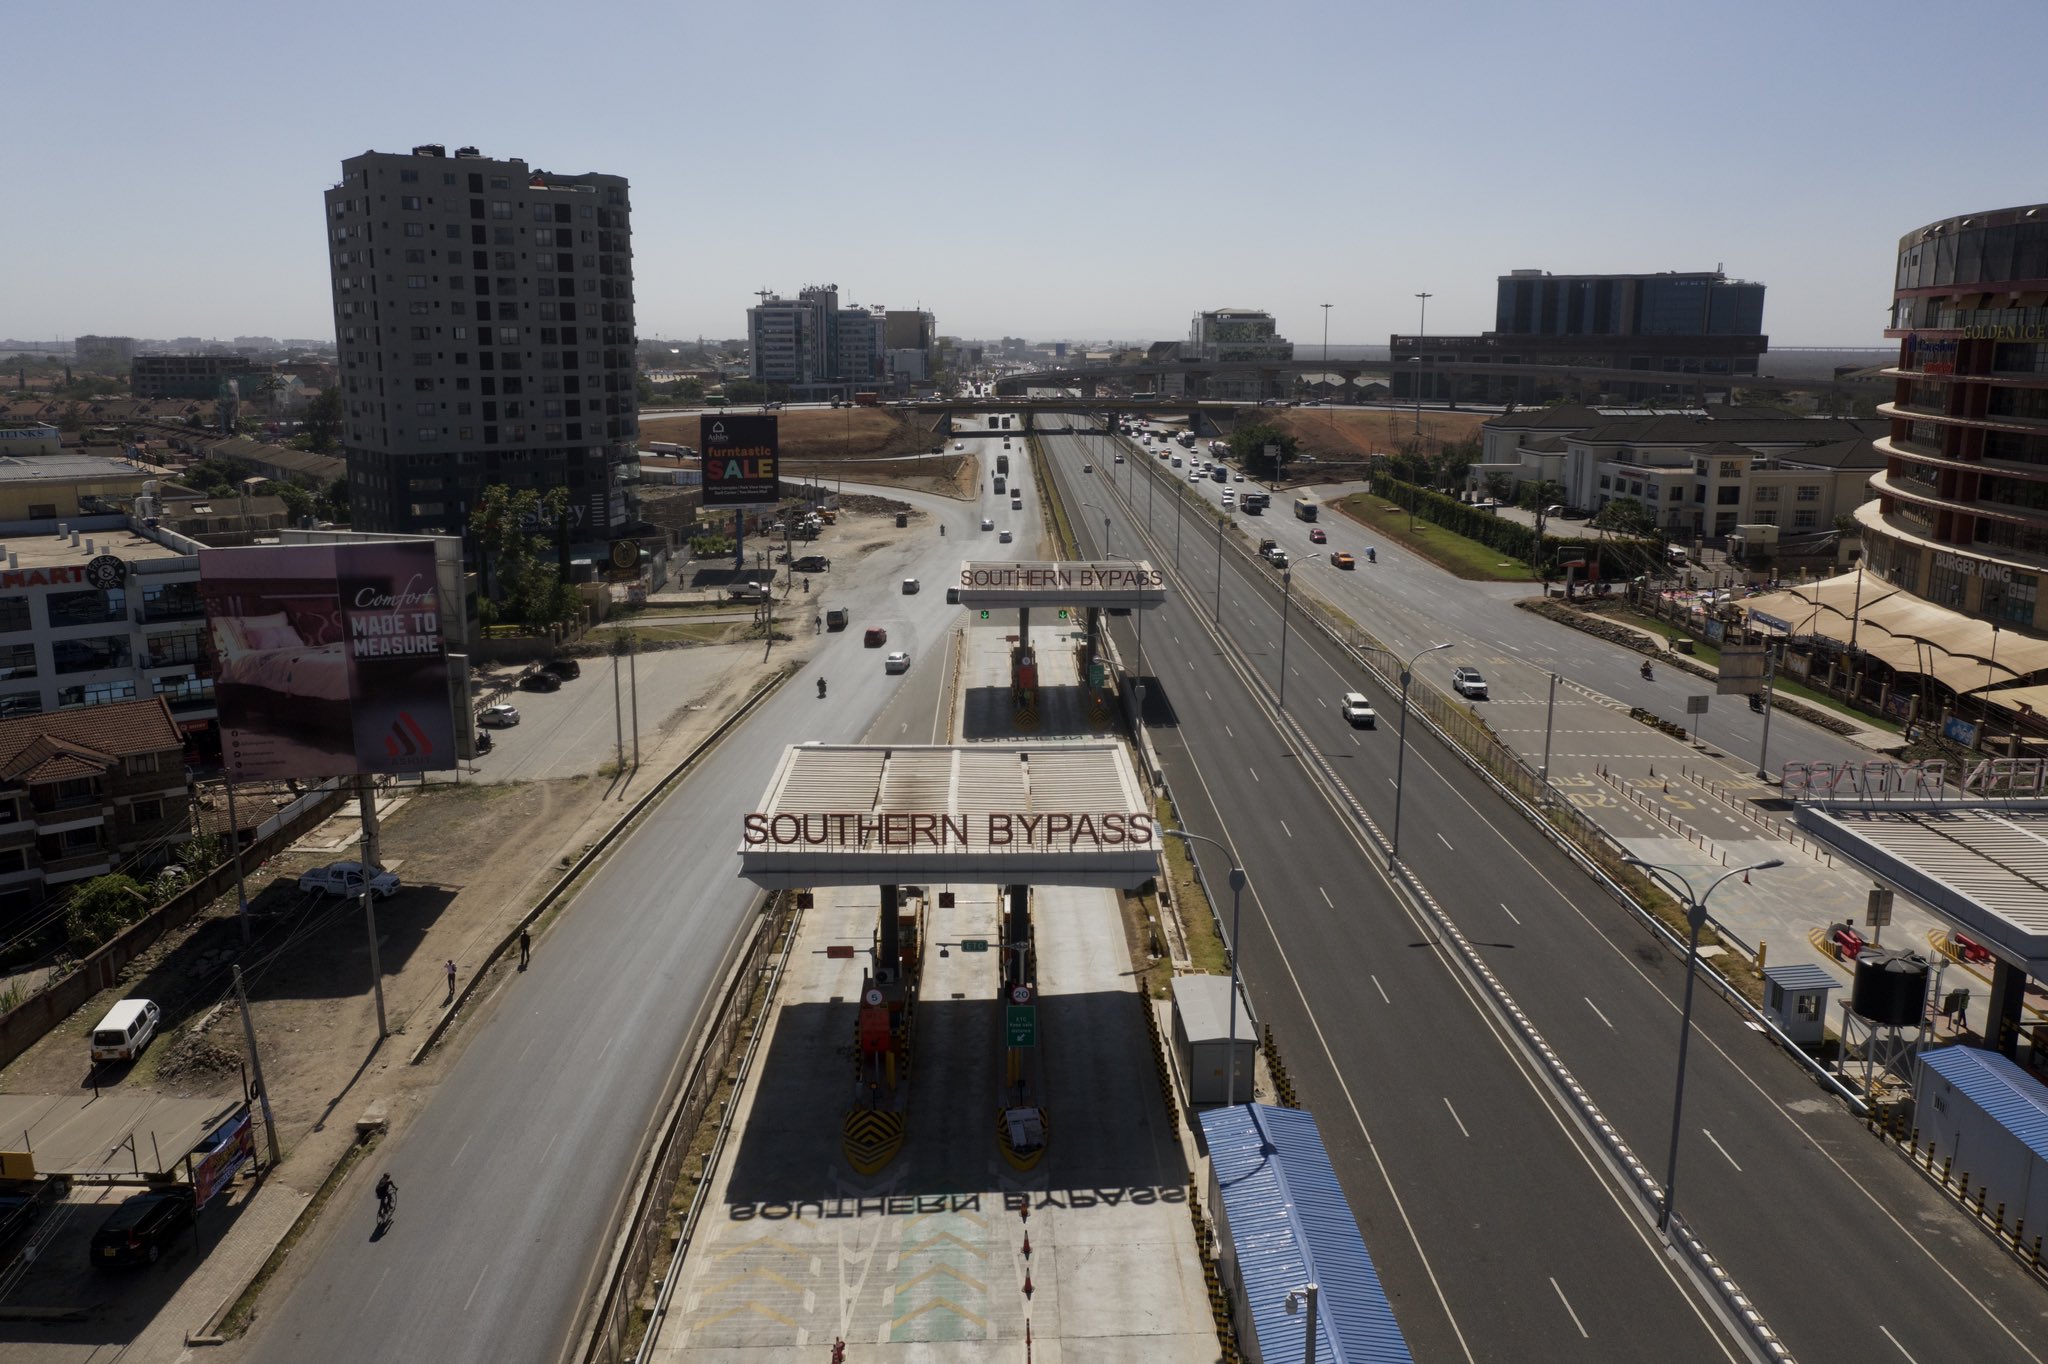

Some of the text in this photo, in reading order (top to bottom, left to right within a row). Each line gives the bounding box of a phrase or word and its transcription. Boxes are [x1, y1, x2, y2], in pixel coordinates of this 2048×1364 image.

[1963, 324, 2046, 340] GOLDEN ICE
[708, 446, 772, 457] furntastic
[707, 458, 774, 480] SALE
[89, 555, 118, 571] FRESH
[1936, 552, 2012, 583] BURGER KING
[0, 566, 85, 588] MART
[97, 575, 122, 589] EASY
[961, 570, 1163, 586] SOUTHERN BYPASS
[355, 573, 433, 617] Comfort
[351, 612, 436, 636] MADE TO
[353, 635, 439, 656] MEASURE
[744, 813, 1153, 846] SOUTHERN BYPASS
[871, 993, 878, 1001] 5
[1015, 991, 1028, 999] 20
